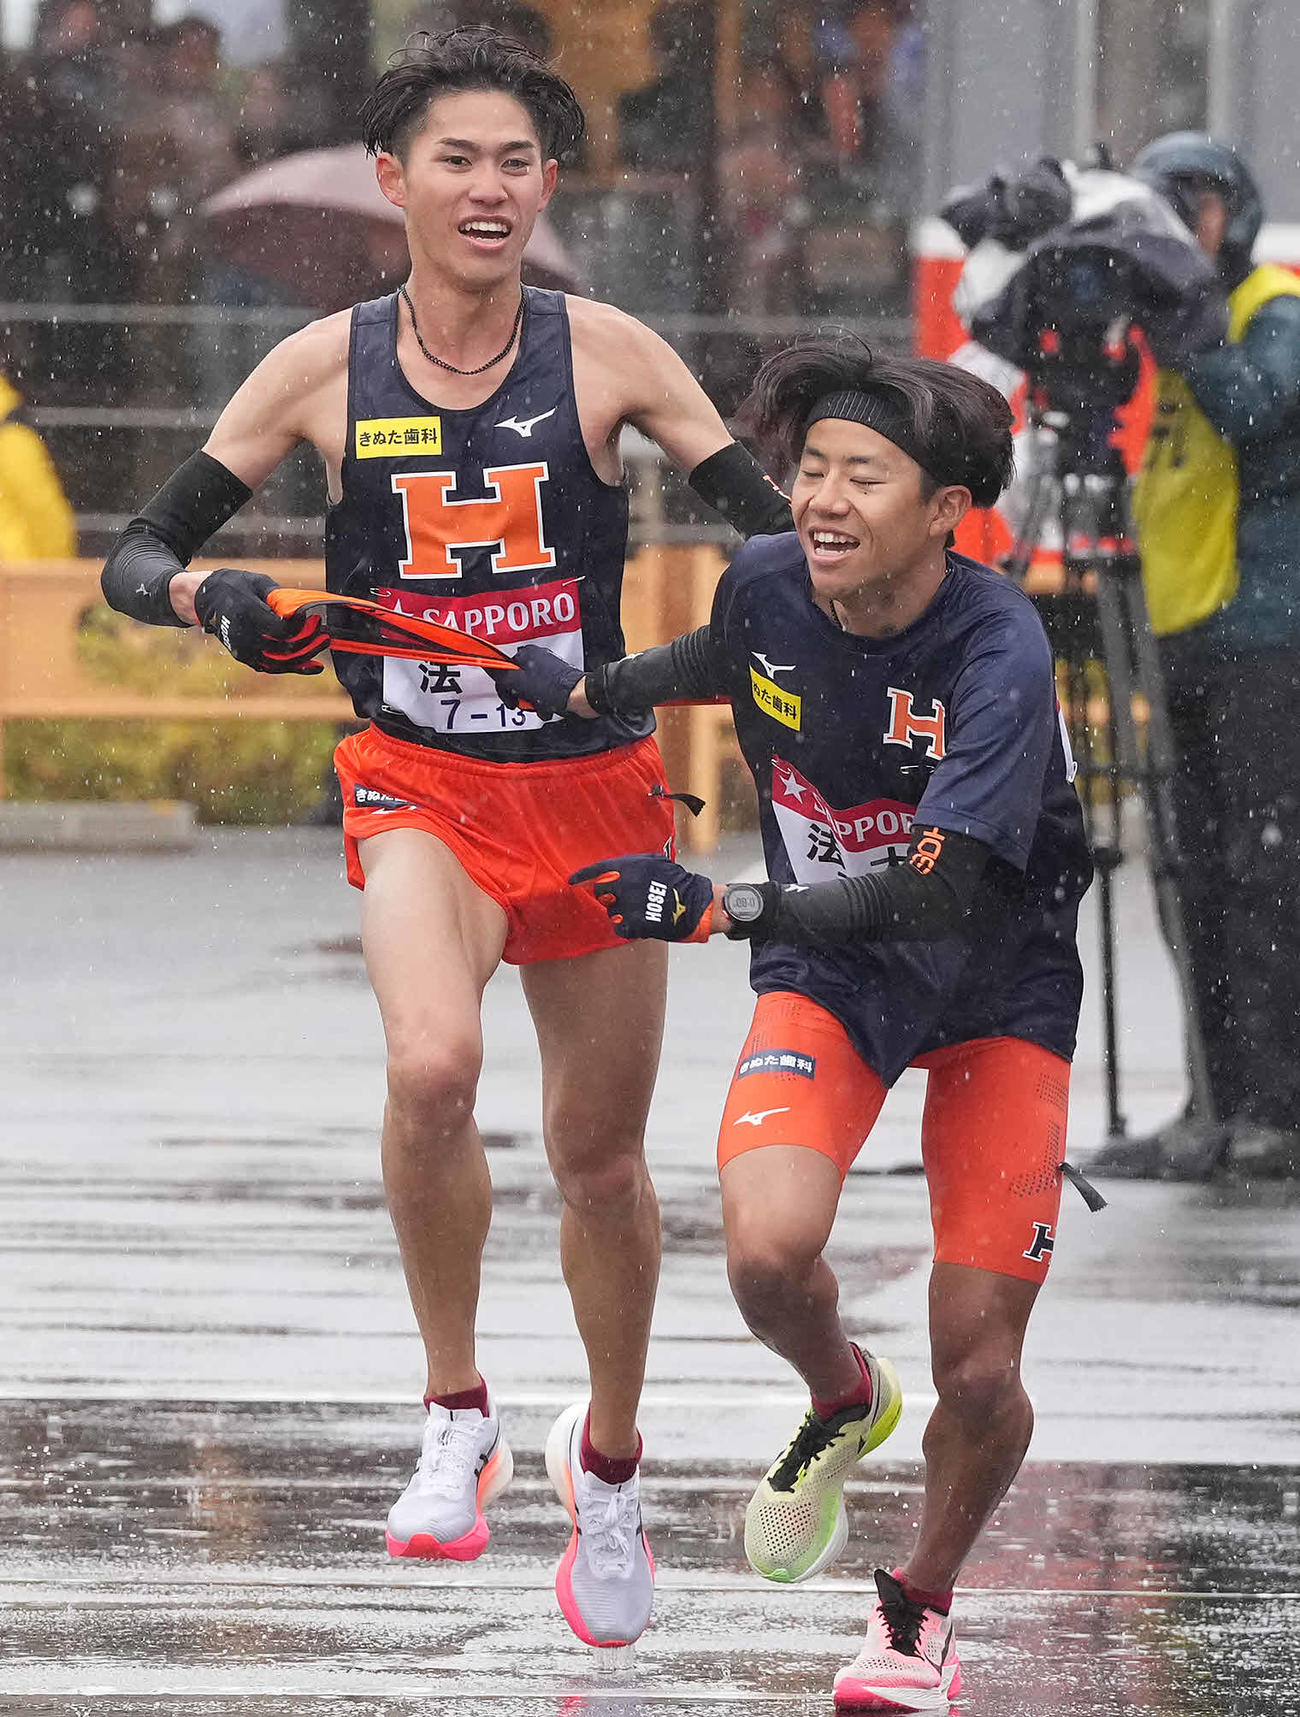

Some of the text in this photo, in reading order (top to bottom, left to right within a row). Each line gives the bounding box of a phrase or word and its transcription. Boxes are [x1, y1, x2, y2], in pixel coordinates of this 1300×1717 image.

[358, 427, 438, 447] きぬた歯科
[391, 461, 557, 579] H
[422, 592, 575, 636] SAPPORO
[883, 686, 946, 760] H
[645, 880, 668, 923] HOSEI
[739, 1053, 813, 1074] きぬた歯科
